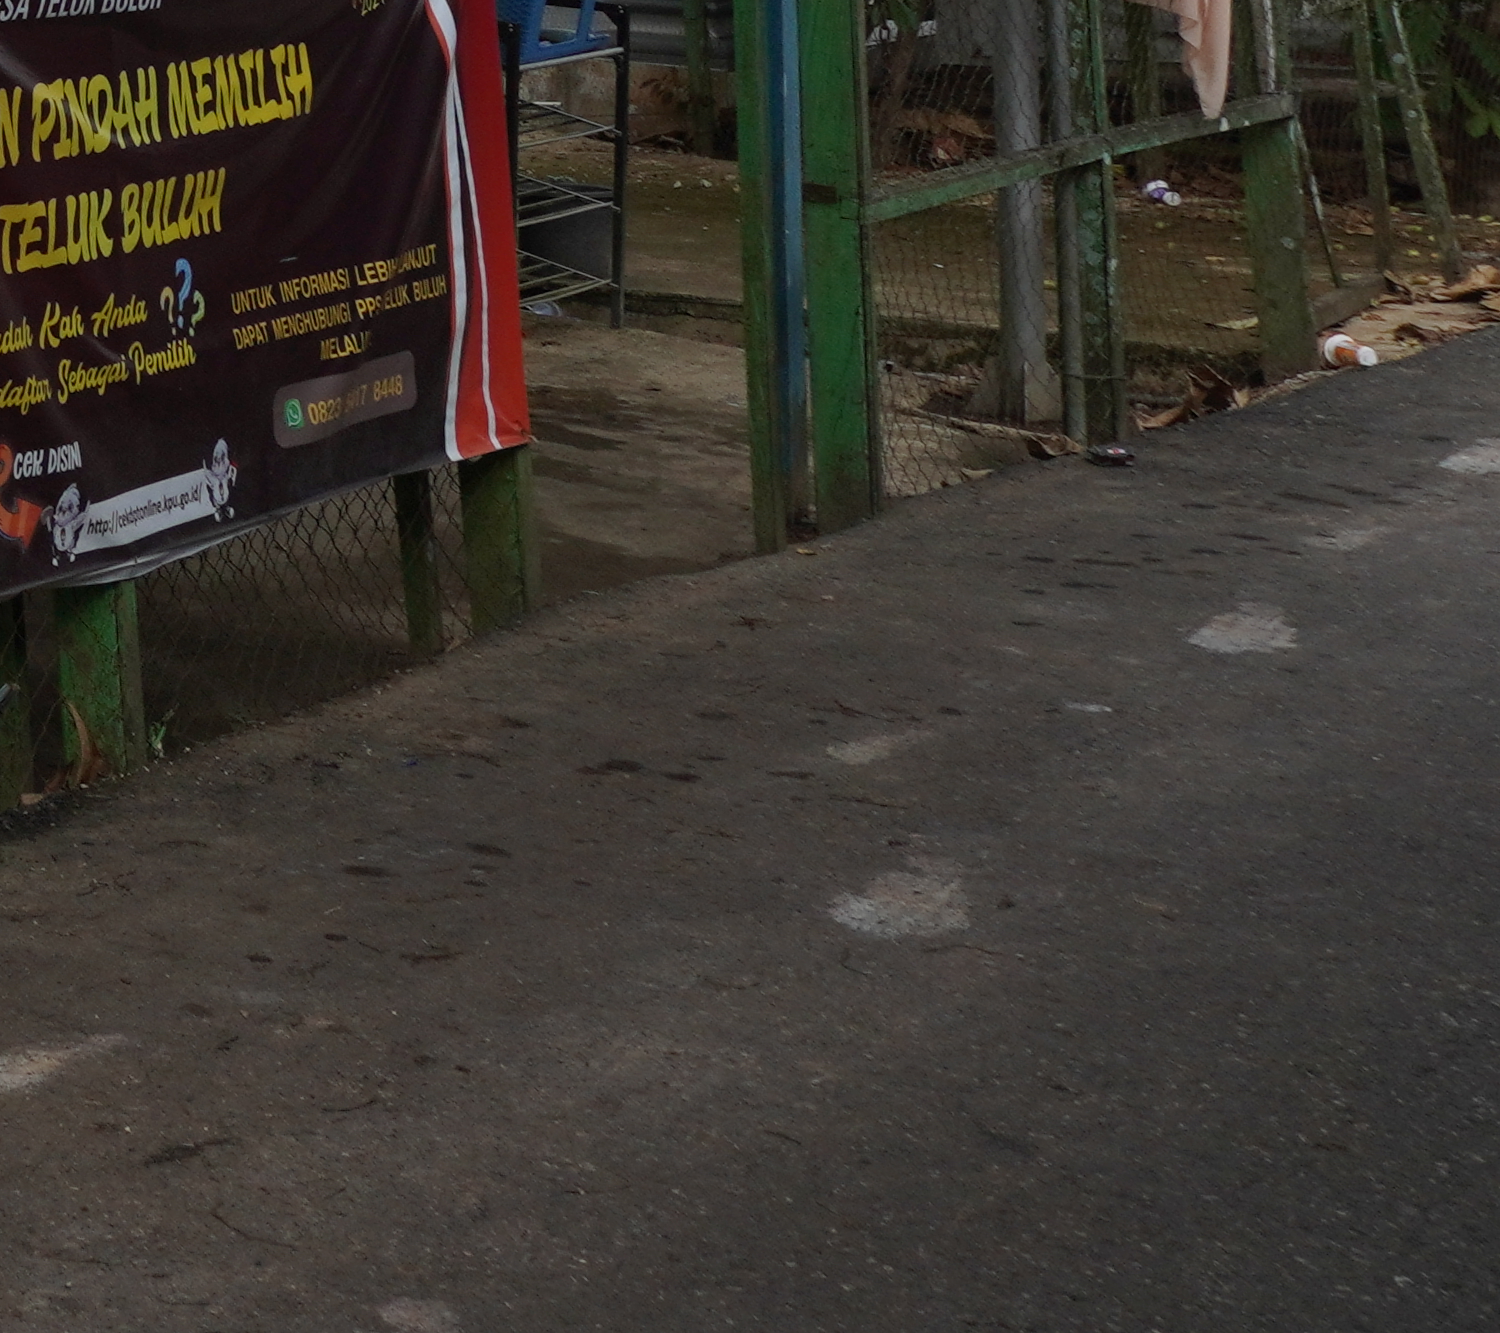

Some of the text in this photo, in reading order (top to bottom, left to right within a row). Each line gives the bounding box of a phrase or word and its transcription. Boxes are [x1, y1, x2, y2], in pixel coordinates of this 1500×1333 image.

[32, 66, 161, 162] PINDAH
[167, 43, 312, 138] MEMILIH
[121, 167, 225, 253] BULUH
[91, 293, 147, 337] Anda
[231, 268, 350, 314] UNTUK INFORMASI
[58, 355, 129, 404] Sebagai
[129, 338, 195, 384] Pemilih
